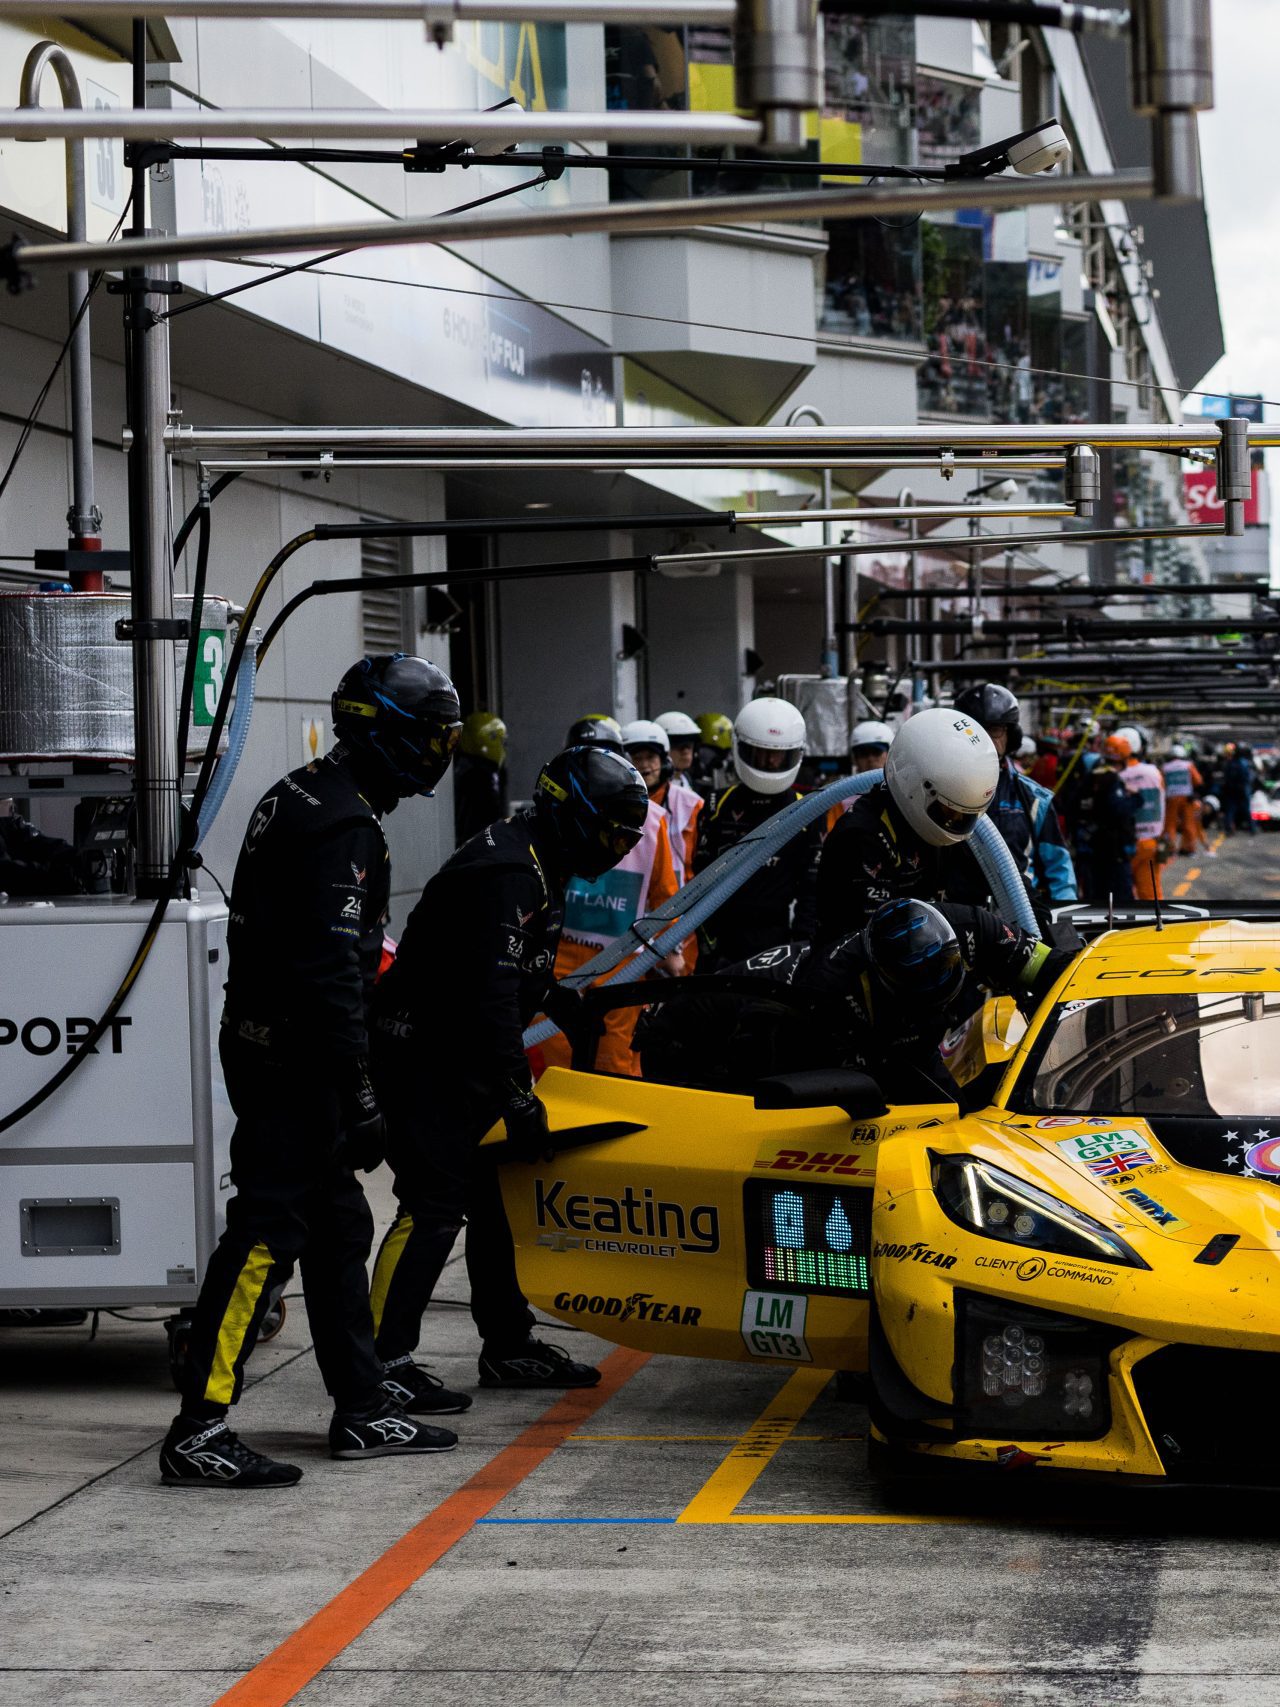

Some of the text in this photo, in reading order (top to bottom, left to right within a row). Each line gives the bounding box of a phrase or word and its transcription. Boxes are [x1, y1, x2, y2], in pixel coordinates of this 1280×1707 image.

[584, 892, 628, 912] LANE
[1074, 1132, 1121, 1149] LM
[1077, 1140, 1138, 1160] GT3
[769, 1149, 862, 1176] DHL
[535, 1179, 720, 1254] Keating
[584, 1239, 677, 1258] CHEVROLET
[974, 1256, 1113, 1286] CLIENT COMMAND
[554, 1292, 701, 1327] GOODYEAR
[755, 1297, 793, 1329] LM
[750, 1330, 800, 1357] GT3
